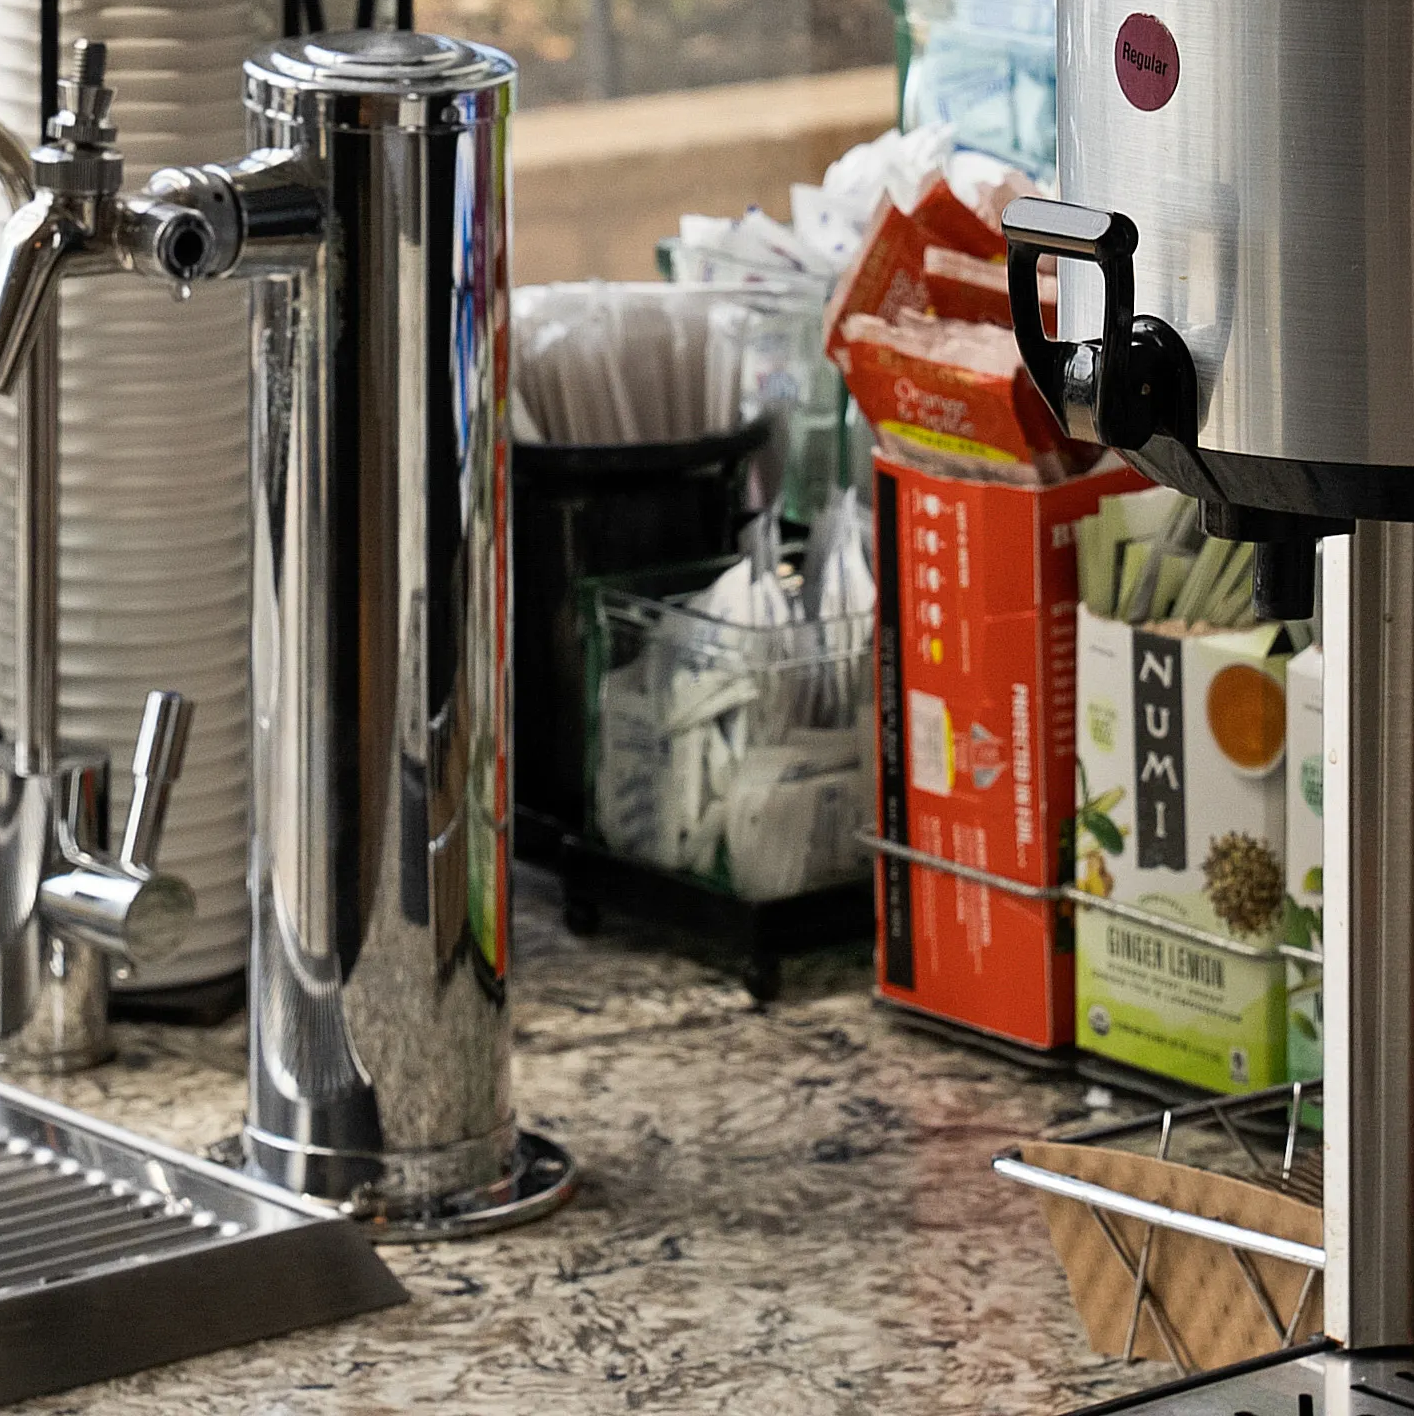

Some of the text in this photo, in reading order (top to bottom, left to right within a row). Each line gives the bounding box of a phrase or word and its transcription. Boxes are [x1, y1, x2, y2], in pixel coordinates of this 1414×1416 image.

[1122, 41, 1169, 77] Regular
[1138, 649, 1181, 840] NUMI
[1106, 924, 1227, 989] GINGER LEMON
